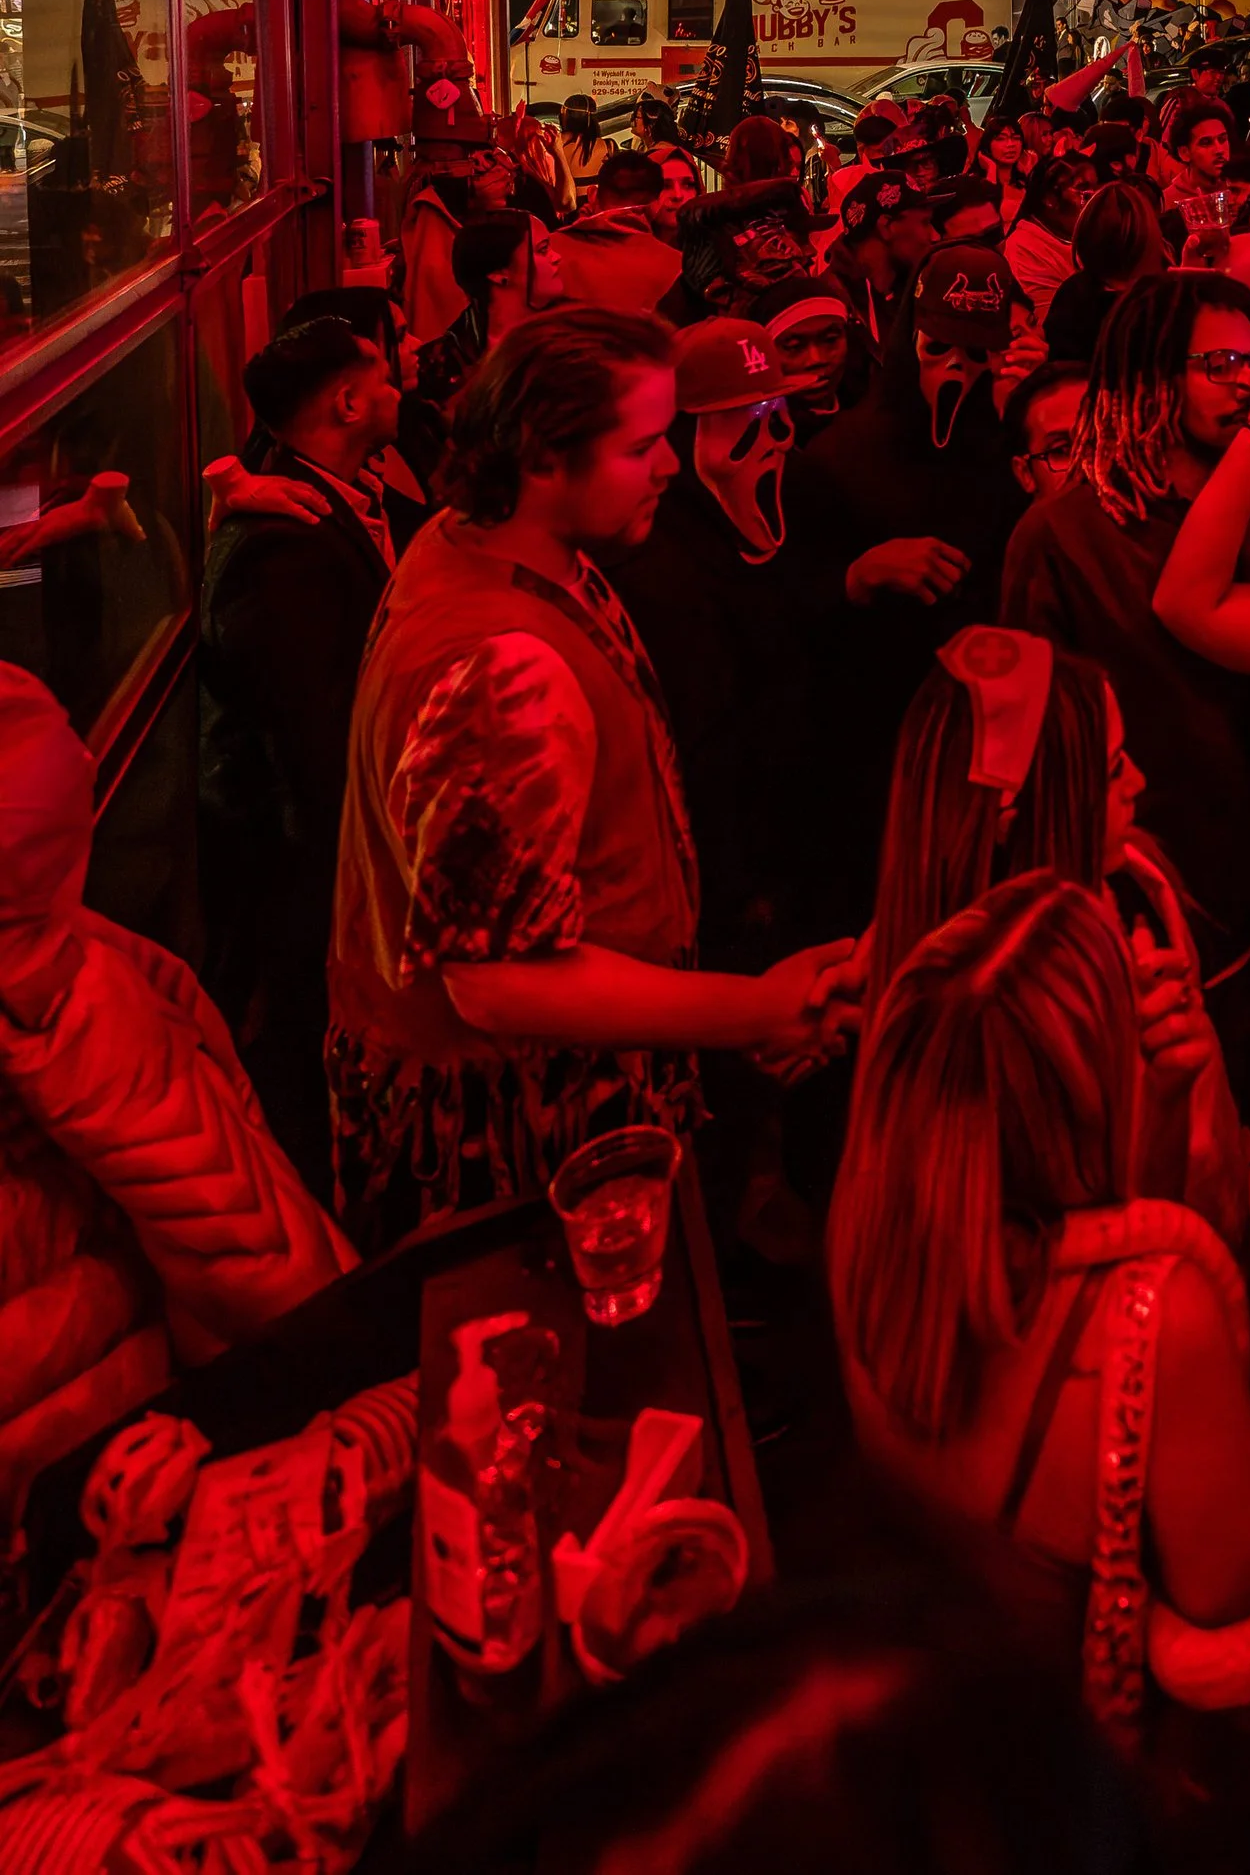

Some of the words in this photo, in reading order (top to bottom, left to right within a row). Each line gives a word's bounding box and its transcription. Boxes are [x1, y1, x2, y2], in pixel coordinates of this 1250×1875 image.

[817, 35, 856, 48] BAR
[592, 78, 620, 88] Brooklyn,
[737, 339, 769, 375] LA
